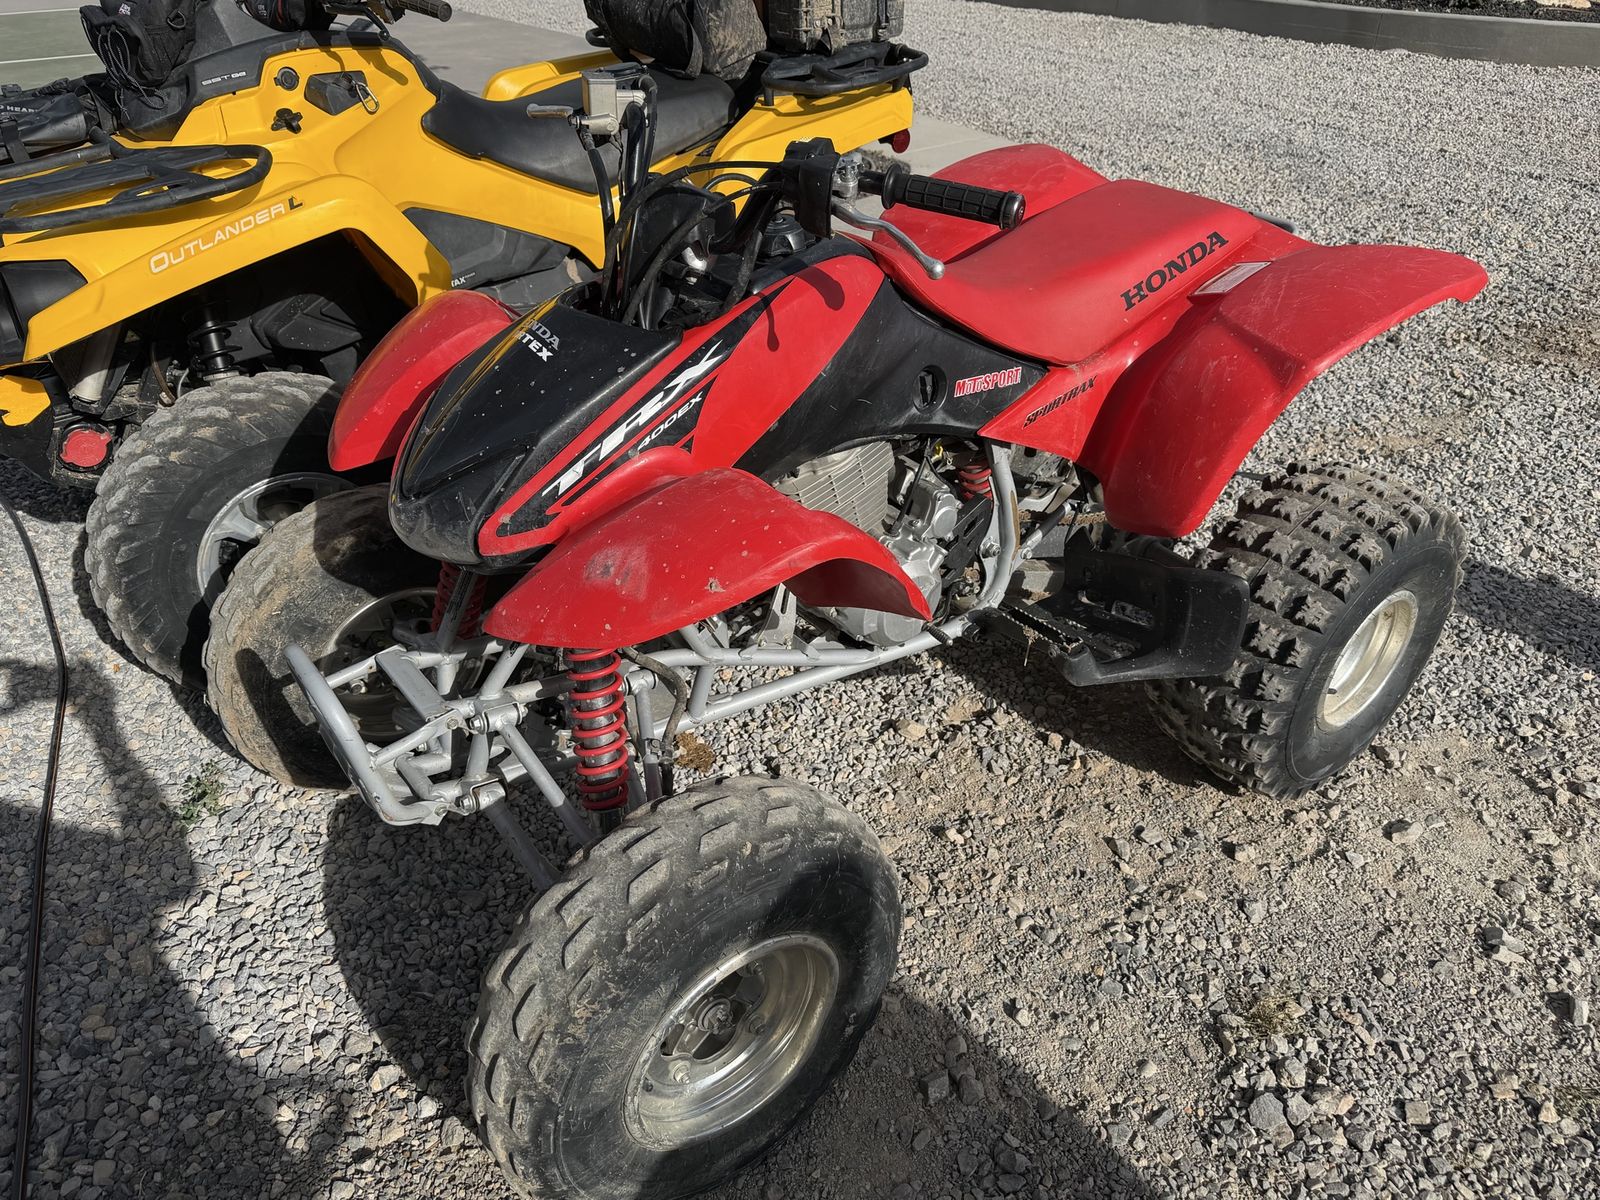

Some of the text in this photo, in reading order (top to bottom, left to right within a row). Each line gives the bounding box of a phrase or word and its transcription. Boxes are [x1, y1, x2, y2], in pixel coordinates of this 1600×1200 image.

[149, 195, 304, 275] OUTLANDER L
[1119, 230, 1230, 312] HONDA
[541, 339, 724, 497] TRX
[637, 390, 704, 451] 400EX
[1023, 374, 1098, 430] SPORTRAX
